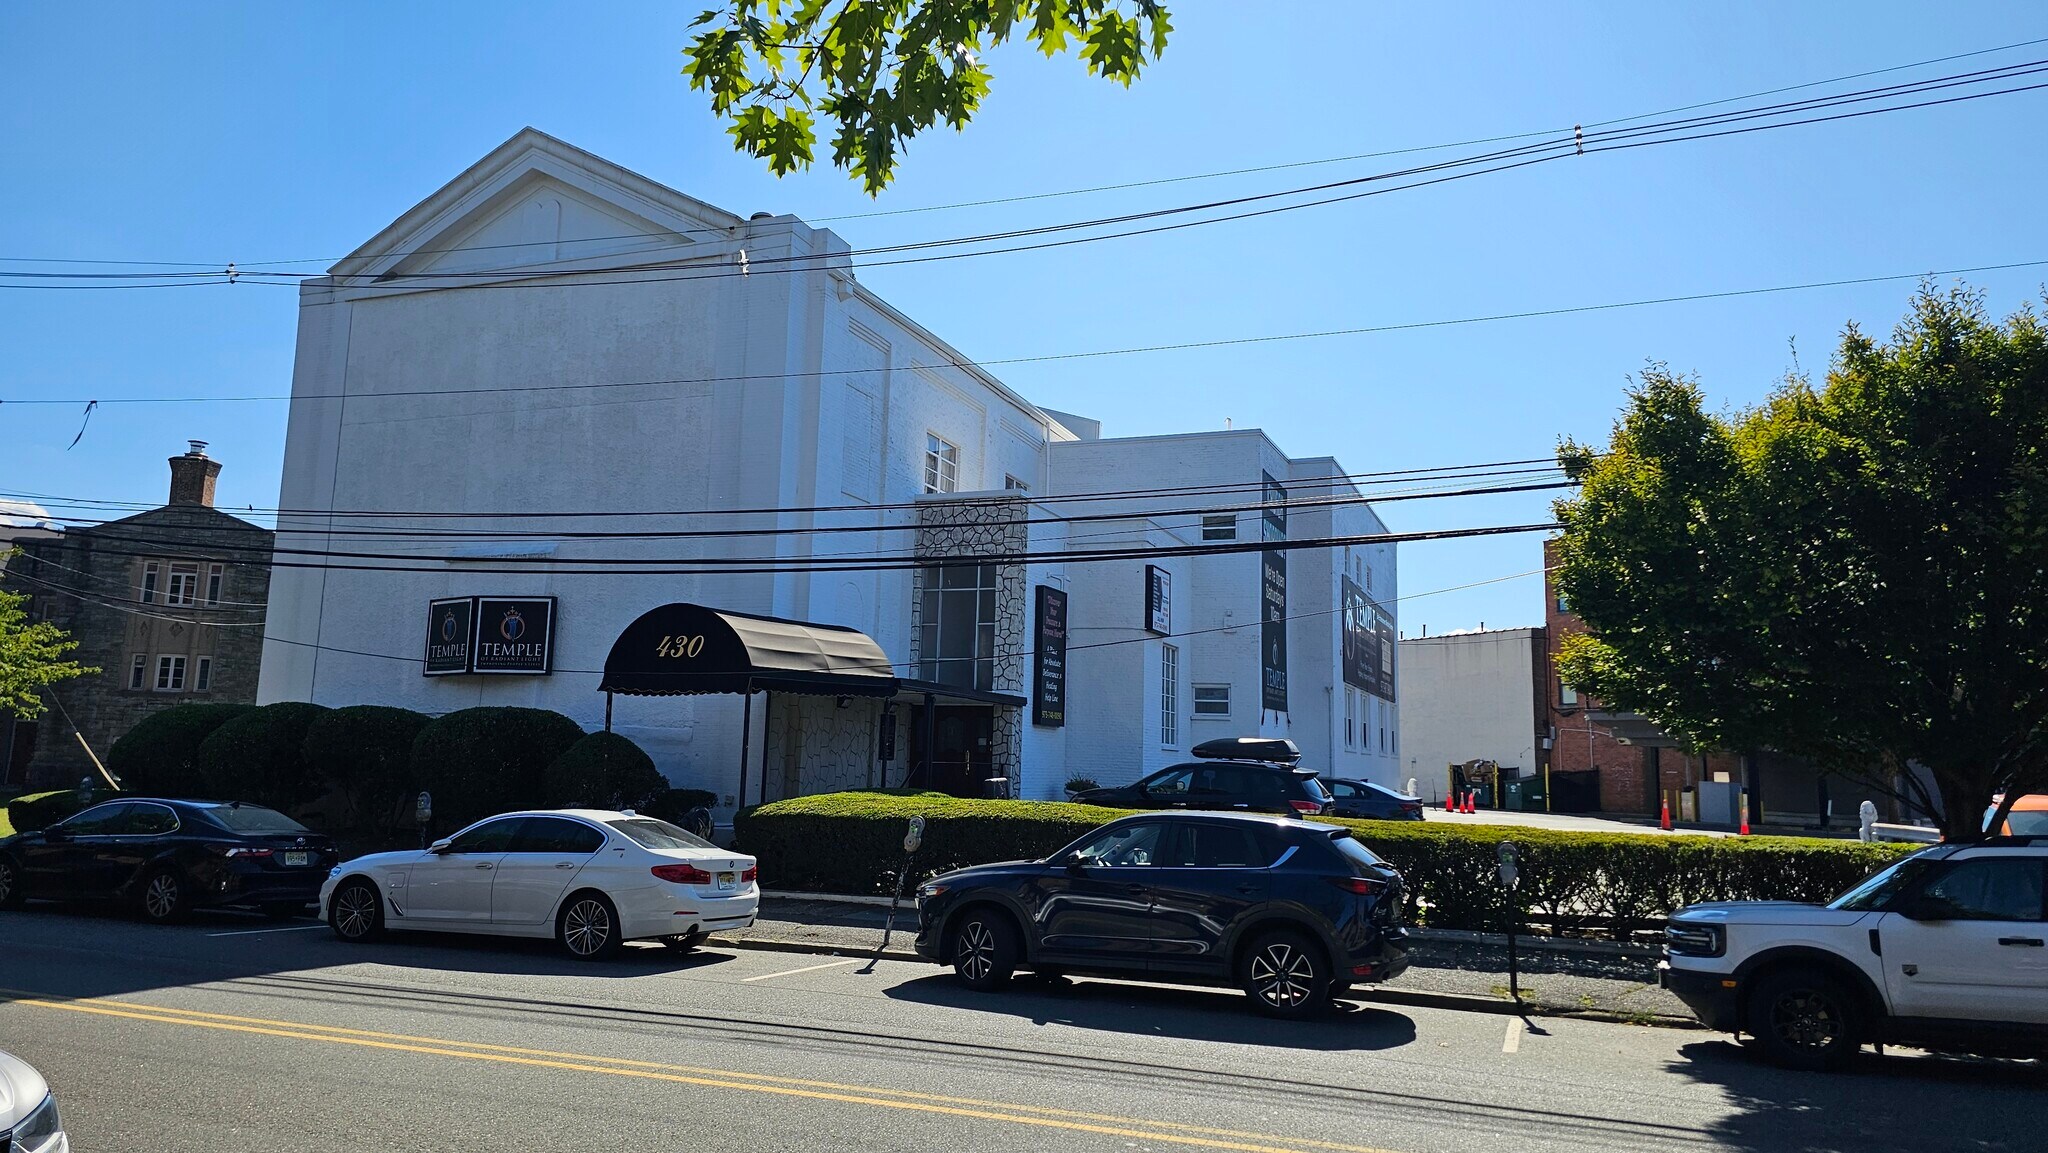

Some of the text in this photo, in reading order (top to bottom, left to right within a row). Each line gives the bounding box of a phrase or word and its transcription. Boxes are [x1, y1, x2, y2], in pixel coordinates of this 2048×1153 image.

[1276, 570, 1285, 589] Open
[1265, 583, 1284, 608] Saturdays
[1355, 594, 1377, 634] TEMPLE
[431, 644, 466, 658] TEMPLE
[482, 643, 542, 656] TEMPLE
[656, 635, 705, 657] 430
[1265, 667, 1285, 690] TEMPLE
